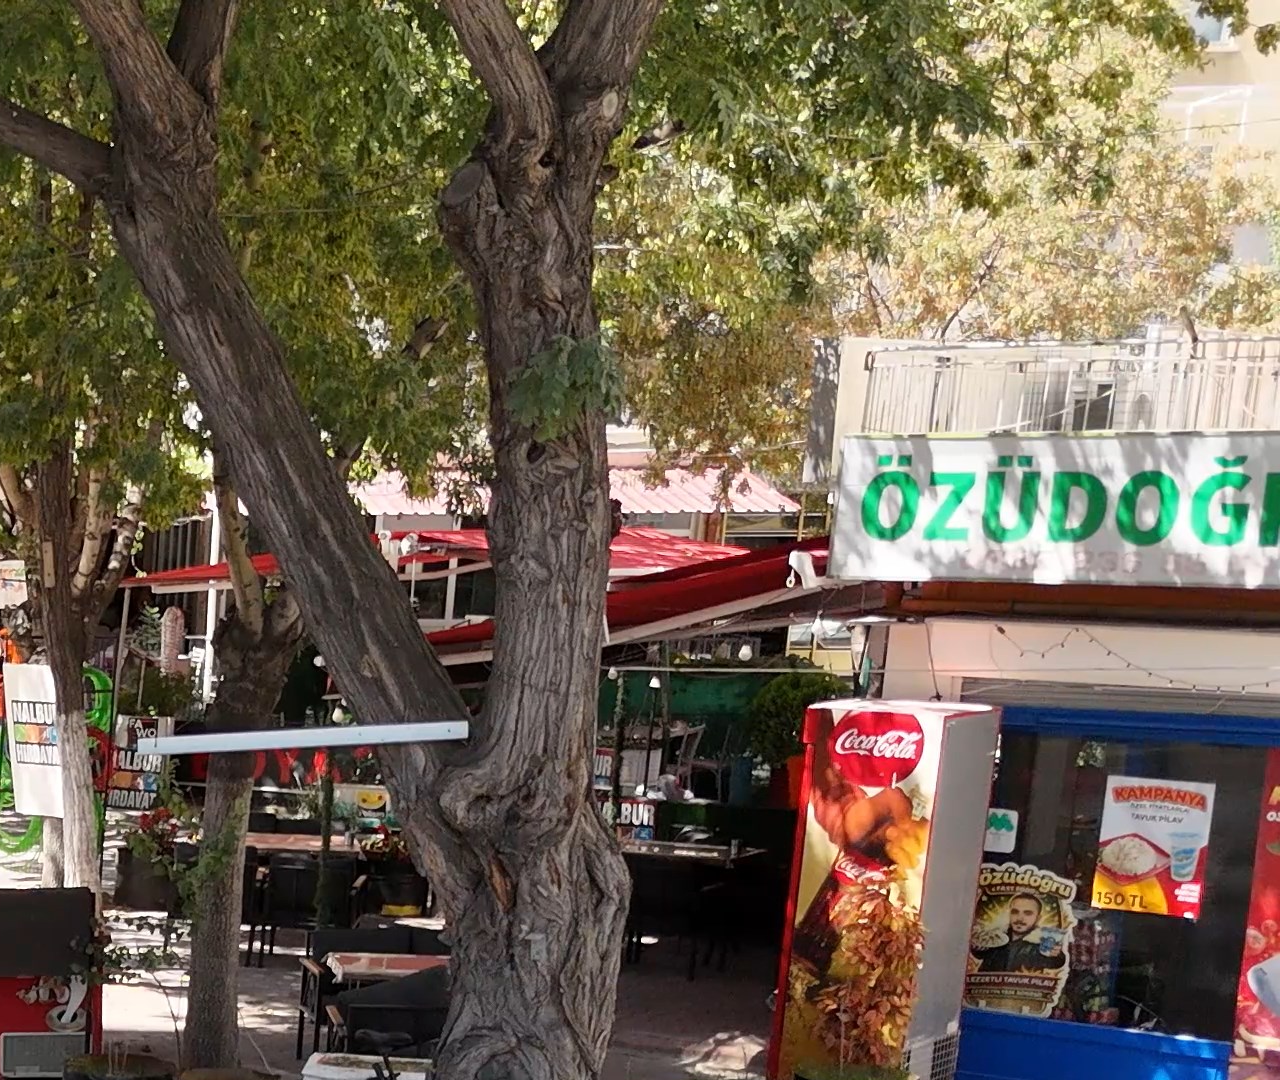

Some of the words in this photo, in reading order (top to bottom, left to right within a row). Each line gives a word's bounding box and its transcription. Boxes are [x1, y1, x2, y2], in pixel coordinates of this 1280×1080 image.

[1113, 787, 1207, 811] KAMPANYA
[616, 802, 655, 826] BUR
[1131, 813, 1157, 822] TAVUK
[1159, 815, 1184, 824] PİLAV
[980, 866, 1072, 898] özüdoğru
[1096, 891, 1125, 906] 150
[1128, 894, 1148, 909] TL
